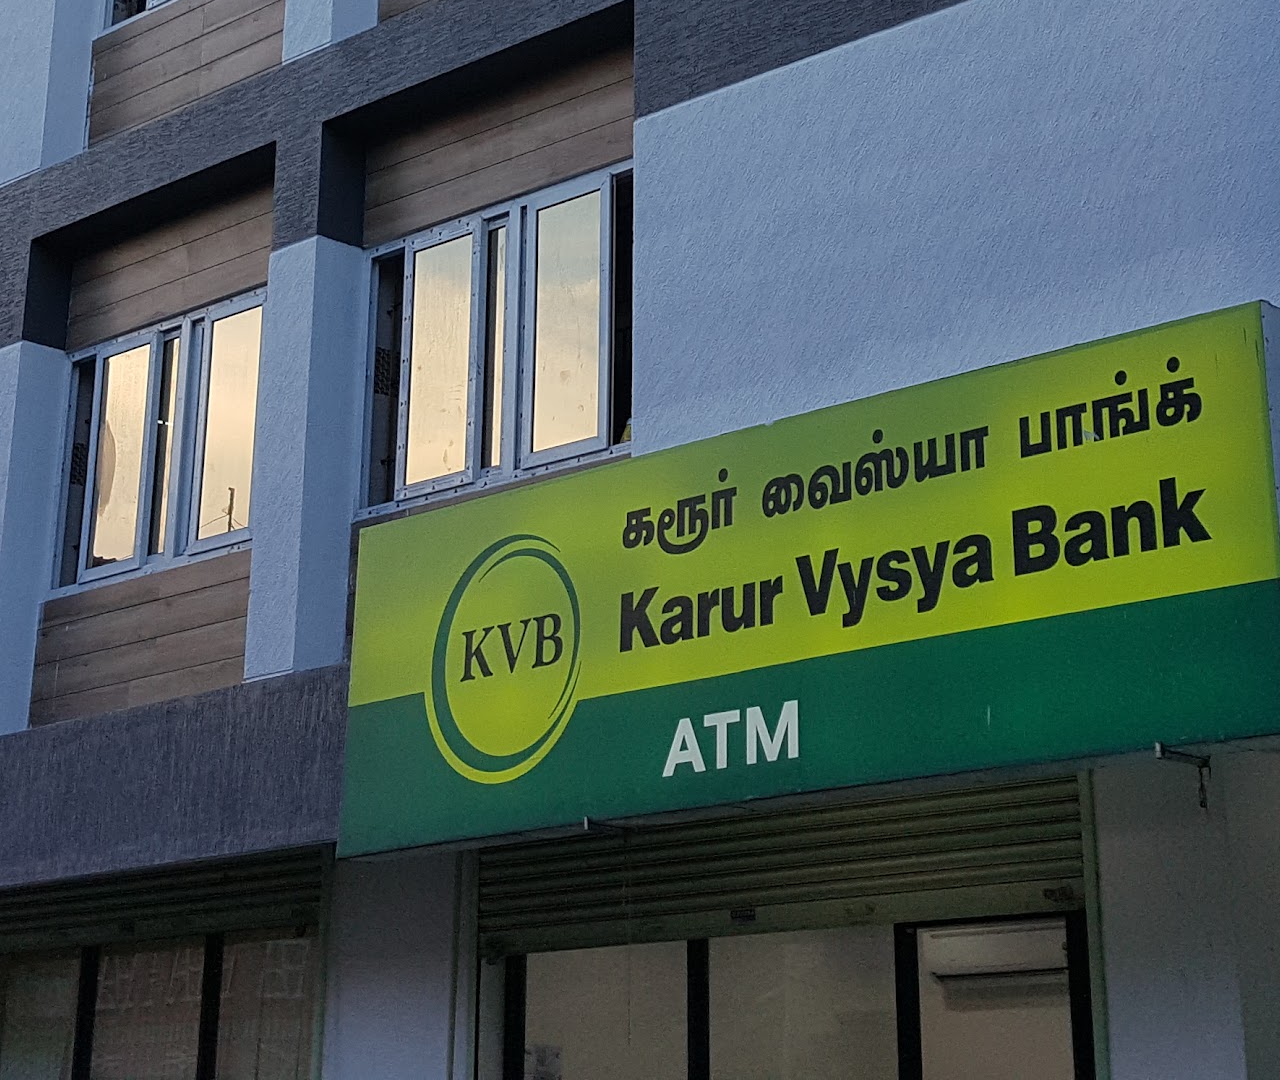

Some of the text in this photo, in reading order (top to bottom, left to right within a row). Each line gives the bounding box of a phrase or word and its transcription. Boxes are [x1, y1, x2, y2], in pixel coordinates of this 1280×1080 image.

[620, 356, 1203, 554] கரூர் வைஸ்யா பாங்க்
[619, 476, 1212, 652] Karur Vysya Bank
[459, 614, 564, 682] KVB
[662, 700, 800, 778] ATM
